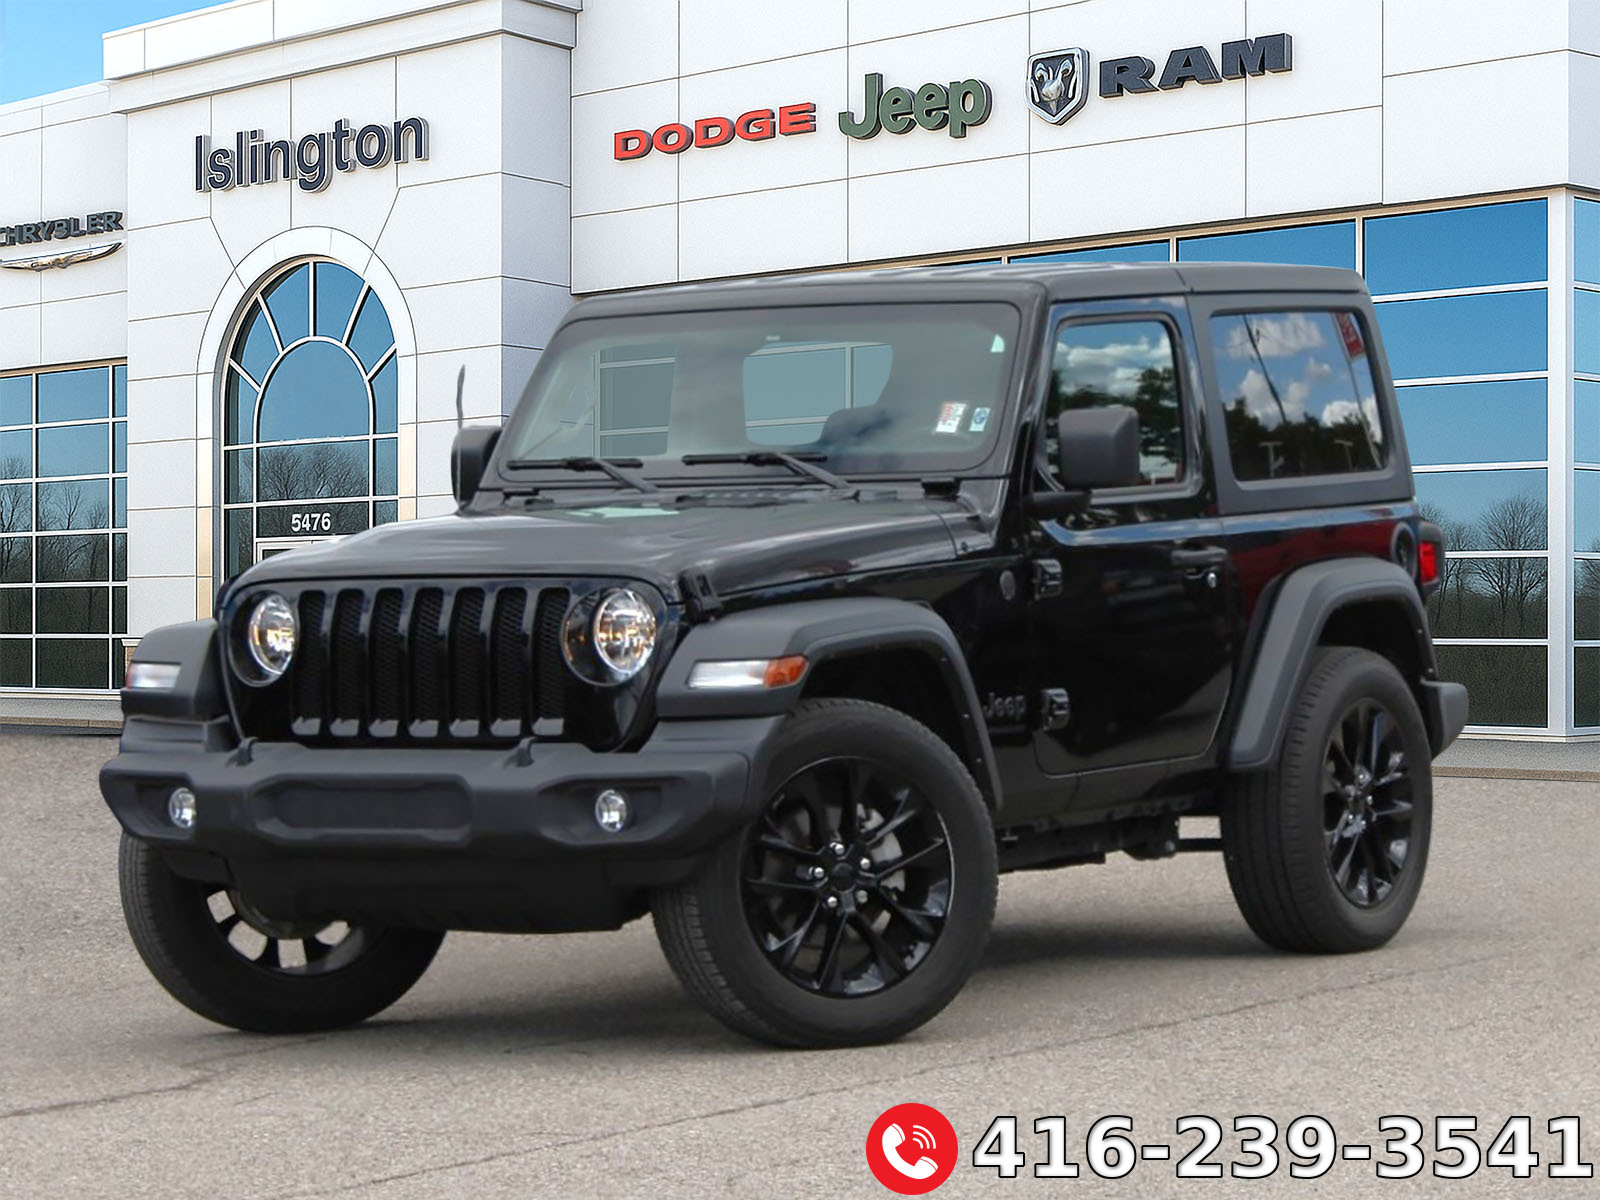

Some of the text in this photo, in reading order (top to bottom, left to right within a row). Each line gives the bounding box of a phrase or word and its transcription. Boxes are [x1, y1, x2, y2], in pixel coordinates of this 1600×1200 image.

[613, 32, 1294, 160] DODGE Jeep RAM
[194, 116, 430, 193] Islington
[291, 512, 331, 532] 5476
